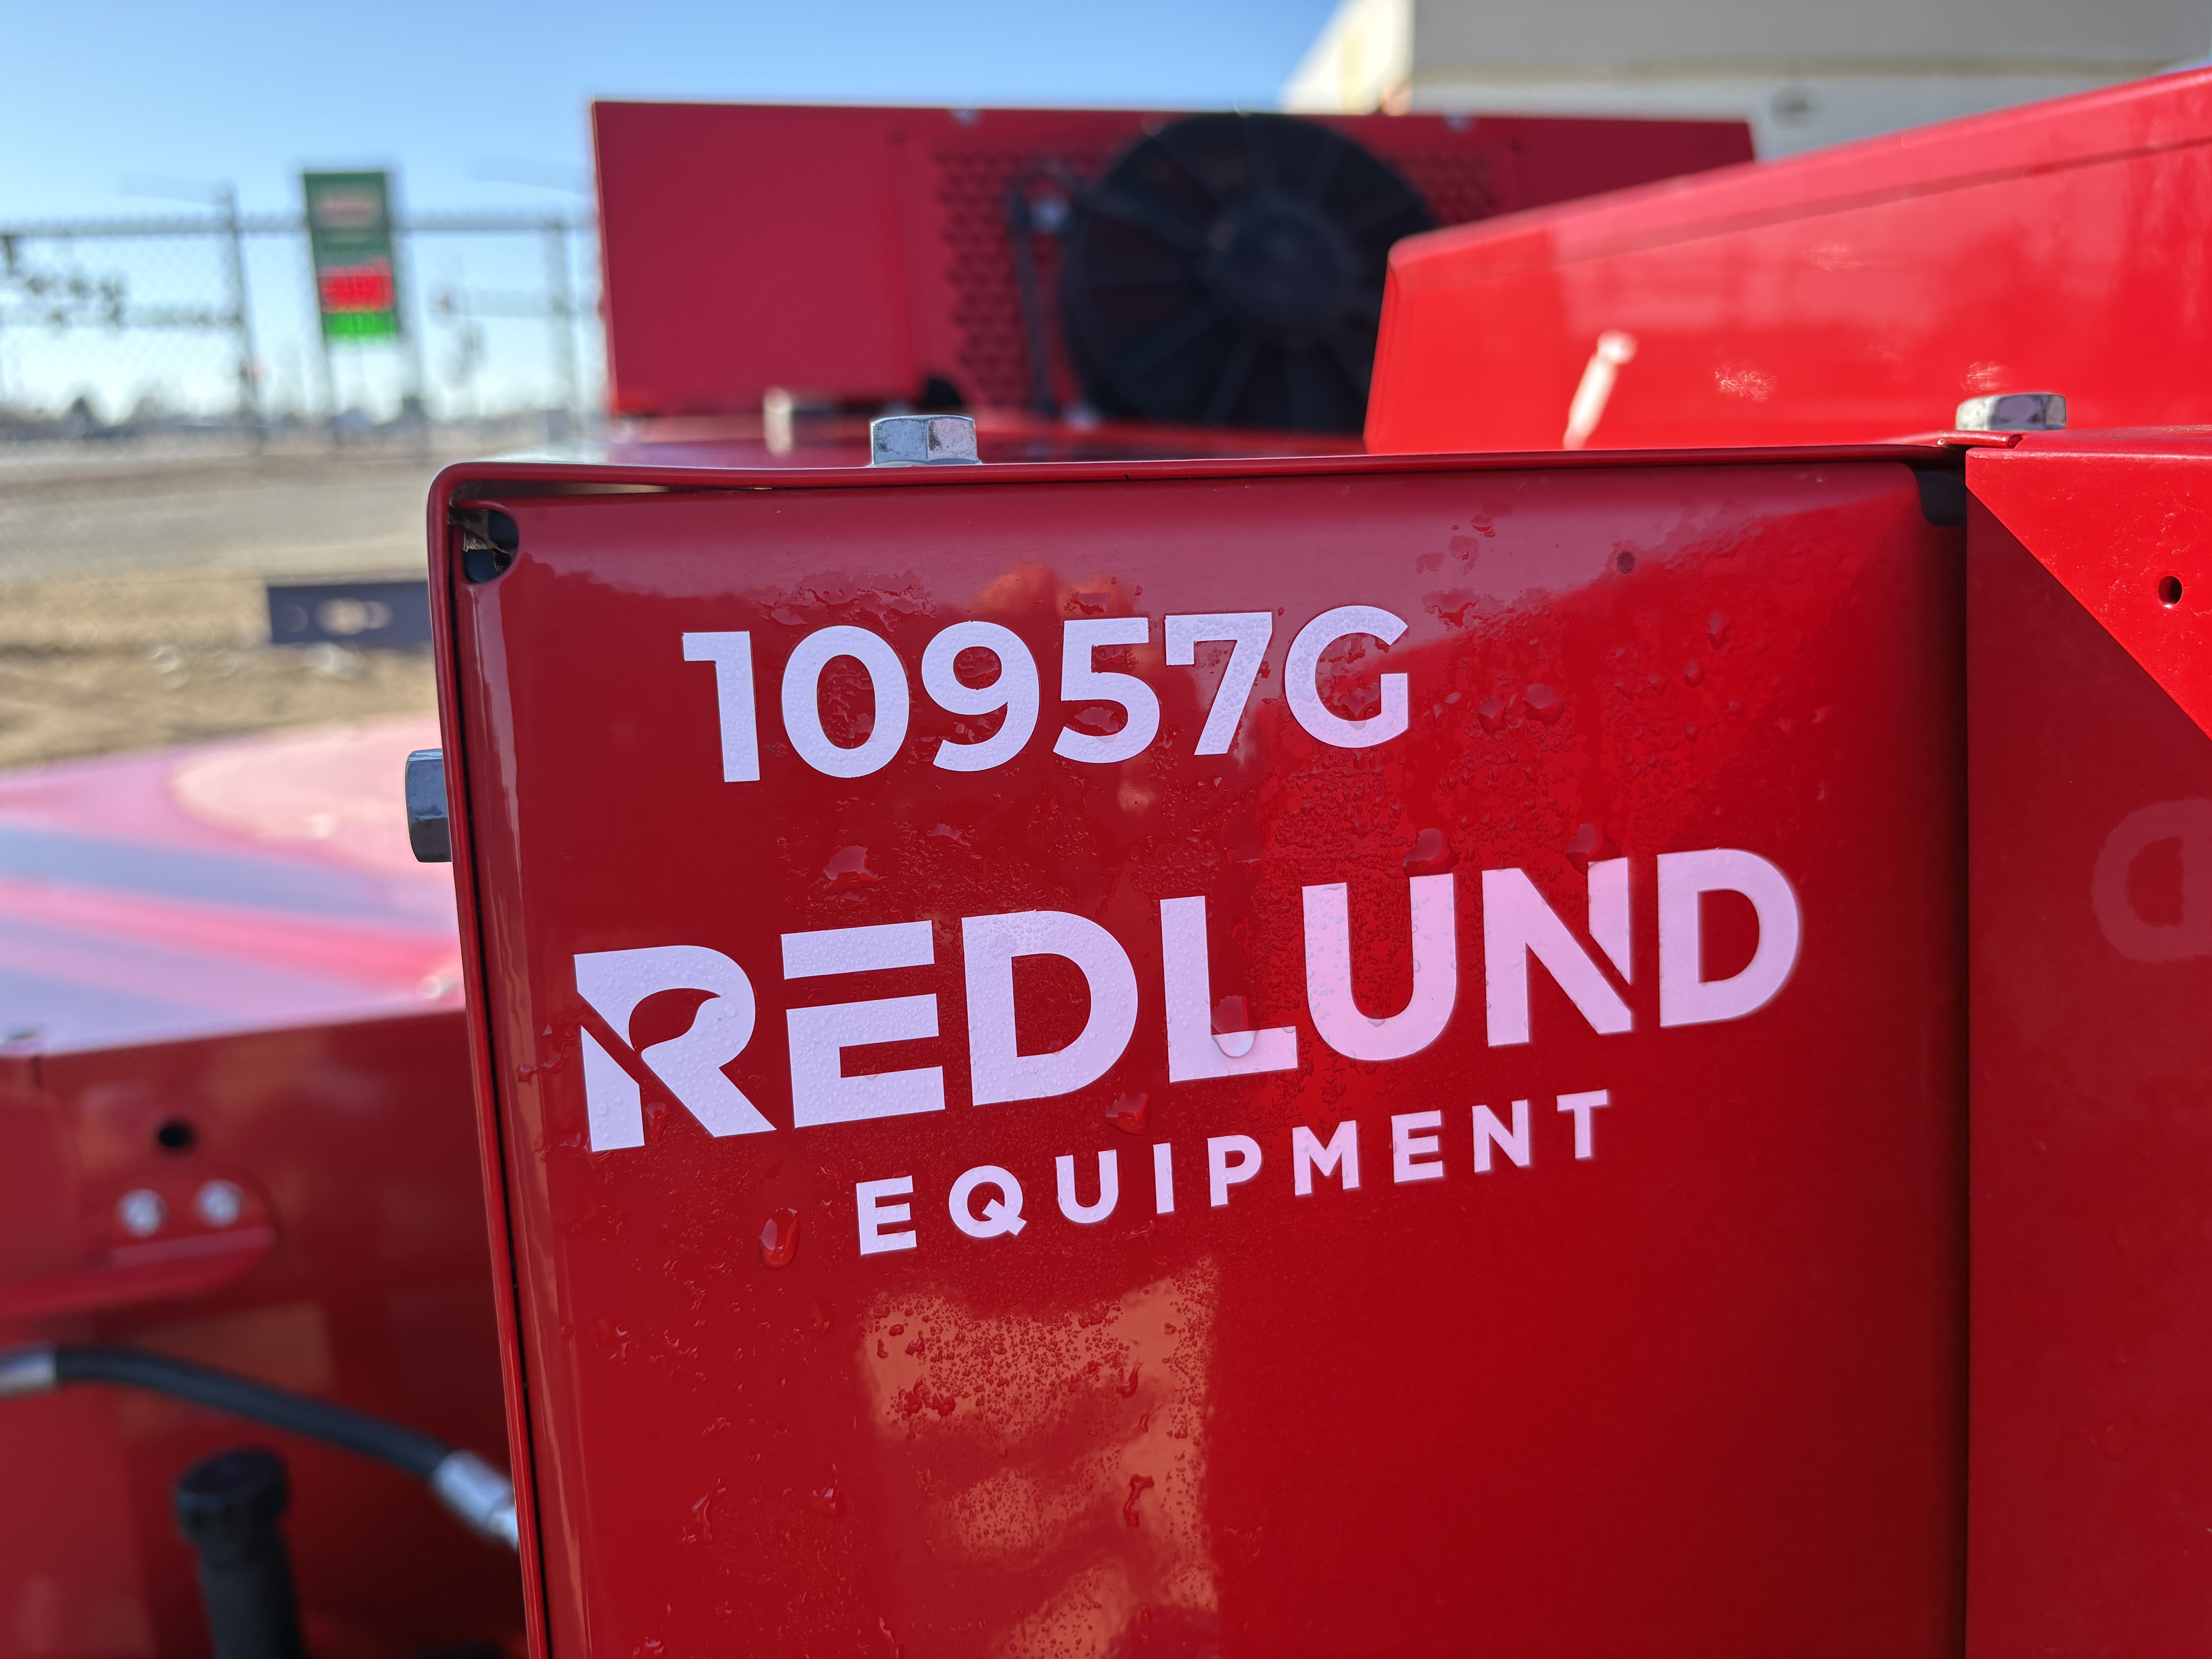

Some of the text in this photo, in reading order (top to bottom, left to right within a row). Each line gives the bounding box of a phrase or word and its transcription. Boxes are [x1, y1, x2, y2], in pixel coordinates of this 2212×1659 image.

[682, 605, 1410, 783] 10957G
[573, 847, 1801, 1152] REDLUND
[855, 1089, 1612, 1255] EQUIPMENT
